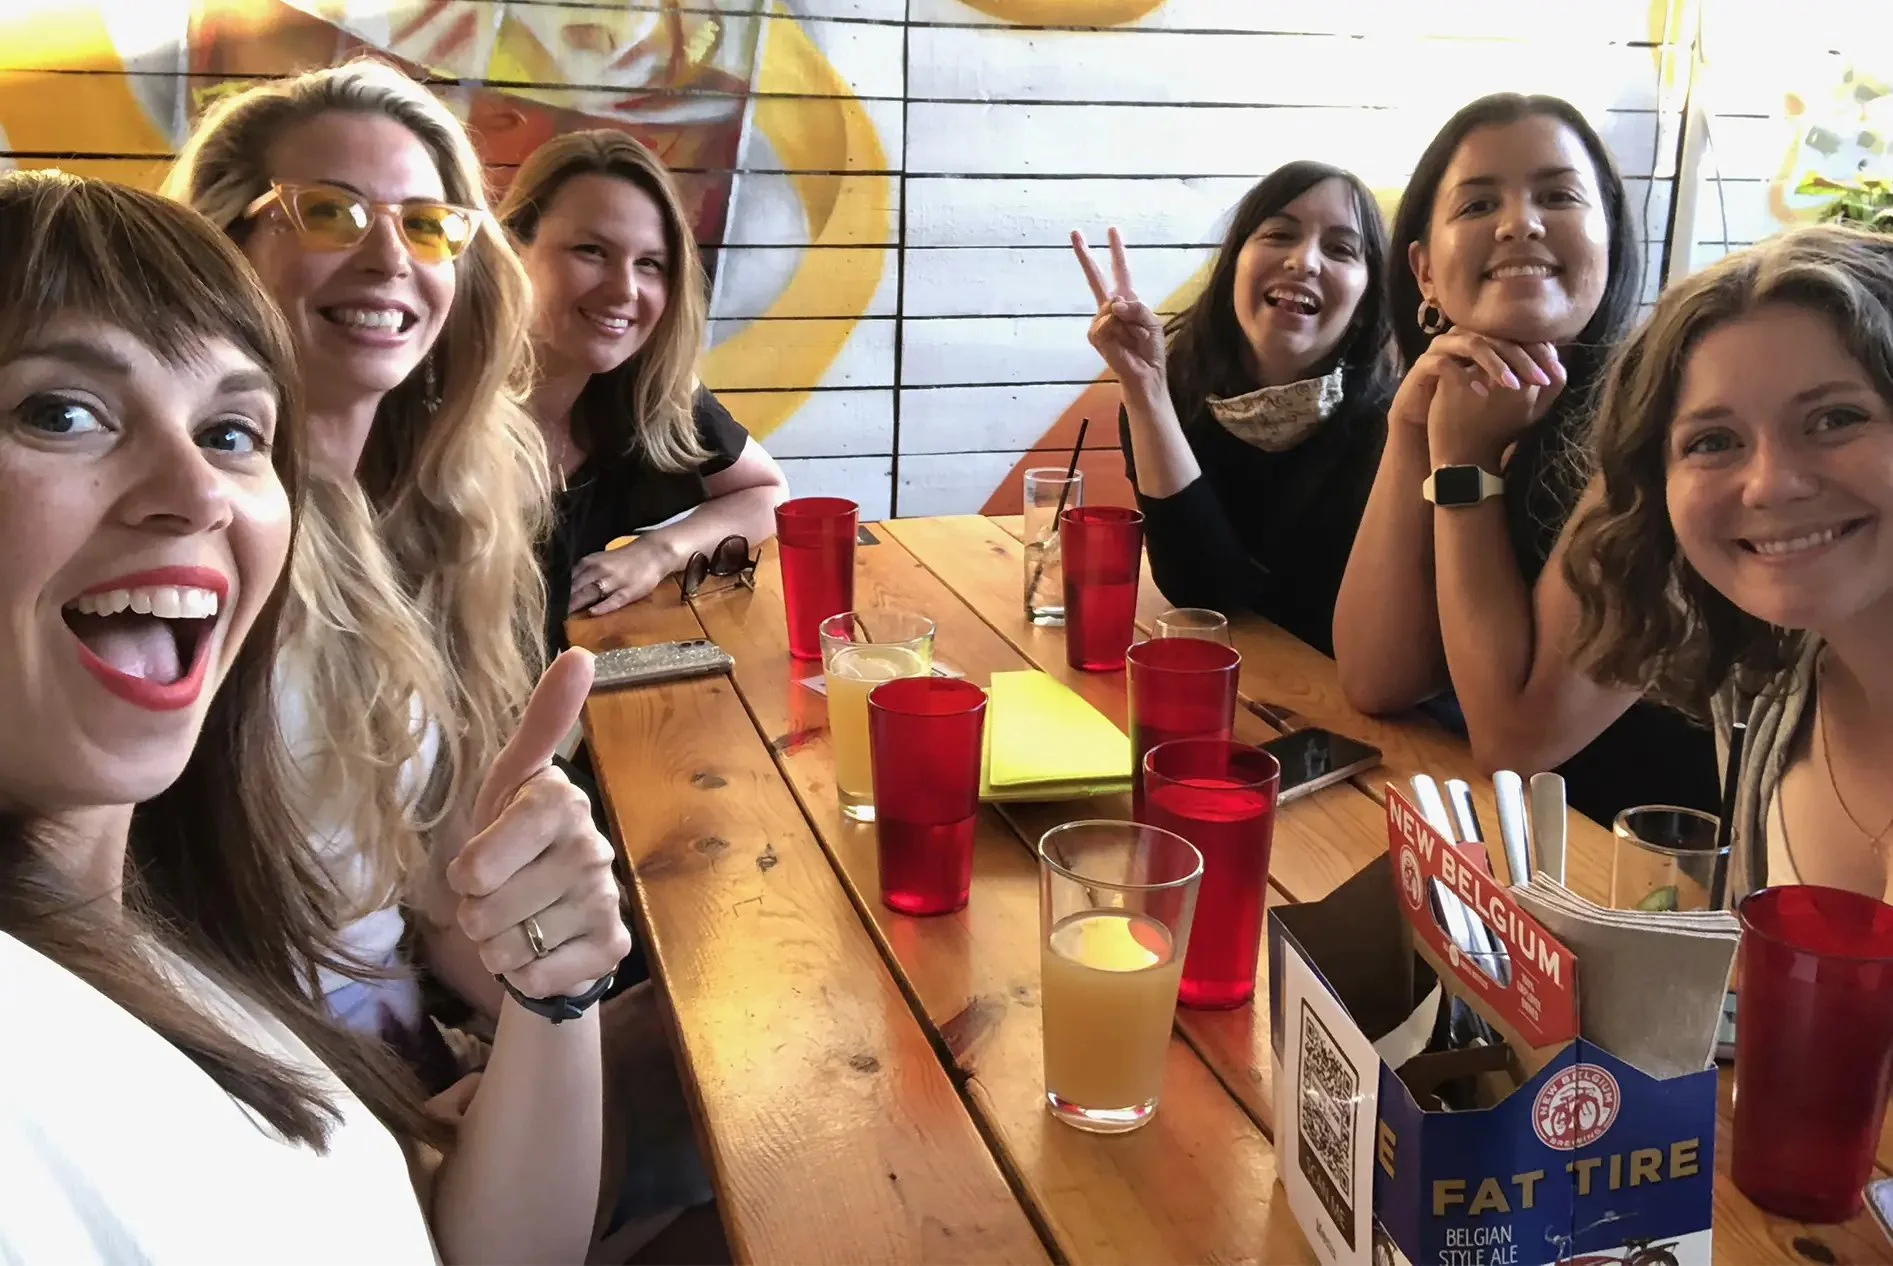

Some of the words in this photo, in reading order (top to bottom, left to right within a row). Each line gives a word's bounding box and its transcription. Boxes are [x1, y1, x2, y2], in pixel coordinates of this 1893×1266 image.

[1389, 795, 1436, 863] NEW
[1441, 847, 1562, 987] BELGIUM
[1540, 1083, 1558, 1116] NEW
[1561, 1070, 1614, 1104] BELGIUM
[1432, 1169, 1545, 1217] FAT
[1566, 1136, 1700, 1196] TIRE
[1438, 1249, 1485, 1266] STYLE
[1490, 1244, 1518, 1266] ALE
[1446, 1224, 1512, 1247] BELGIAN
